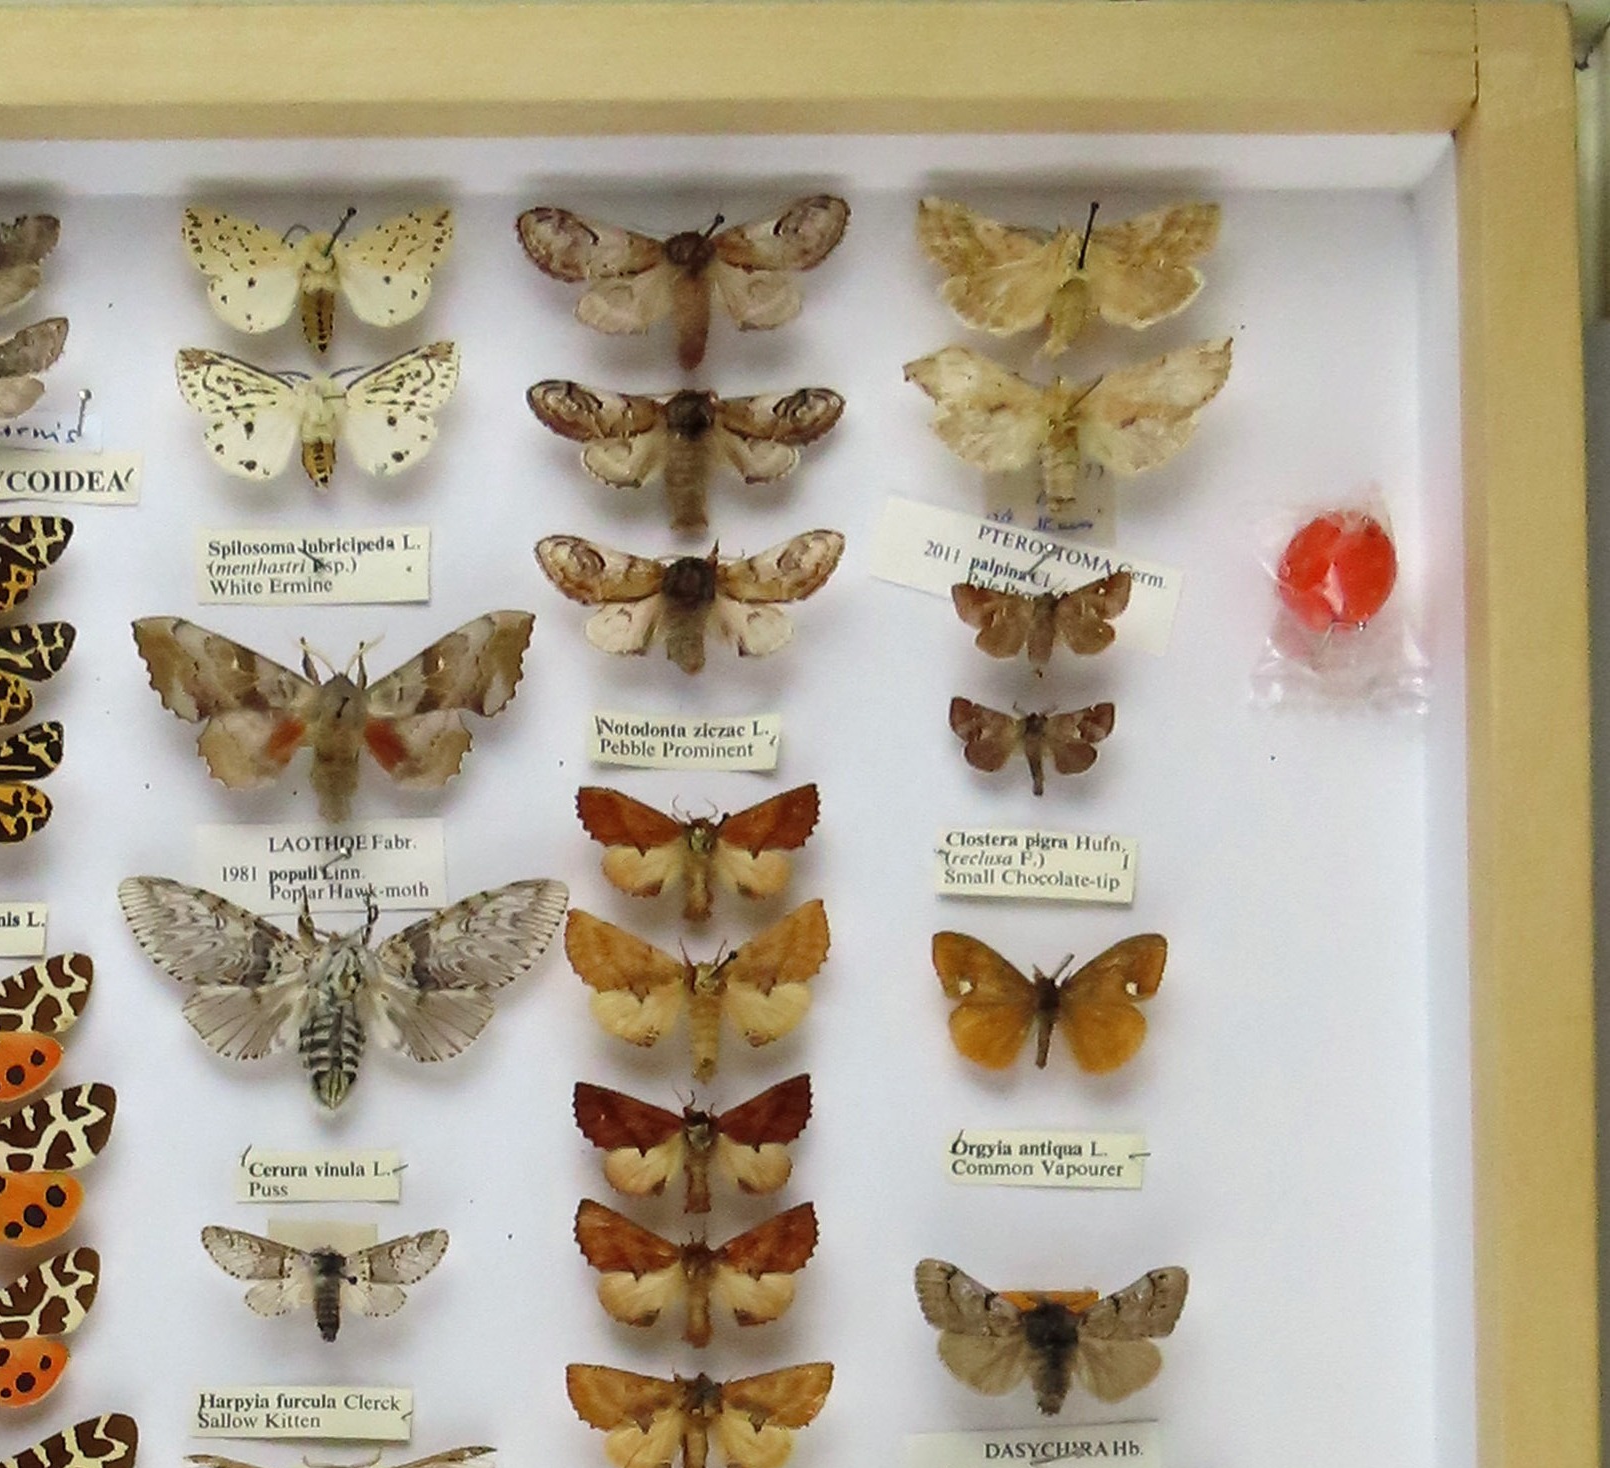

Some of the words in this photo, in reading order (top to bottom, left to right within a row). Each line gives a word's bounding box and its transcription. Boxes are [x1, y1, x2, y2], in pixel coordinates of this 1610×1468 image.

[208, 578, 263, 596] White
[269, 579, 333, 595] Ermine
[599, 719, 686, 738] Notodonta
[692, 722, 746, 739] ziczac
[600, 738, 655, 756] Pebble
[662, 741, 754, 758] Prominent
[221, 866, 257, 882] 1981
[268, 866, 317, 885] populi
[944, 869, 994, 886] Small
[1001, 870, 1121, 890] Chocolate-tip
[950, 1140, 1013, 1161] Orgyia
[1018, 1140, 1083, 1160] antiqua
[248, 1161, 307, 1178] Cerura
[314, 1161, 365, 1177] vinula
[951, 1159, 1033, 1177] Common
[1040, 1160, 1124, 1179] Vapourer
[248, 1181, 289, 1198] Puss
[200, 1393, 270, 1412] Harpyia
[276, 1393, 337, 1410] furcula
[343, 1394, 400, 1411] Clerck
[198, 1412, 258, 1429] Sallow
[265, 1413, 321, 1429] Kitten
